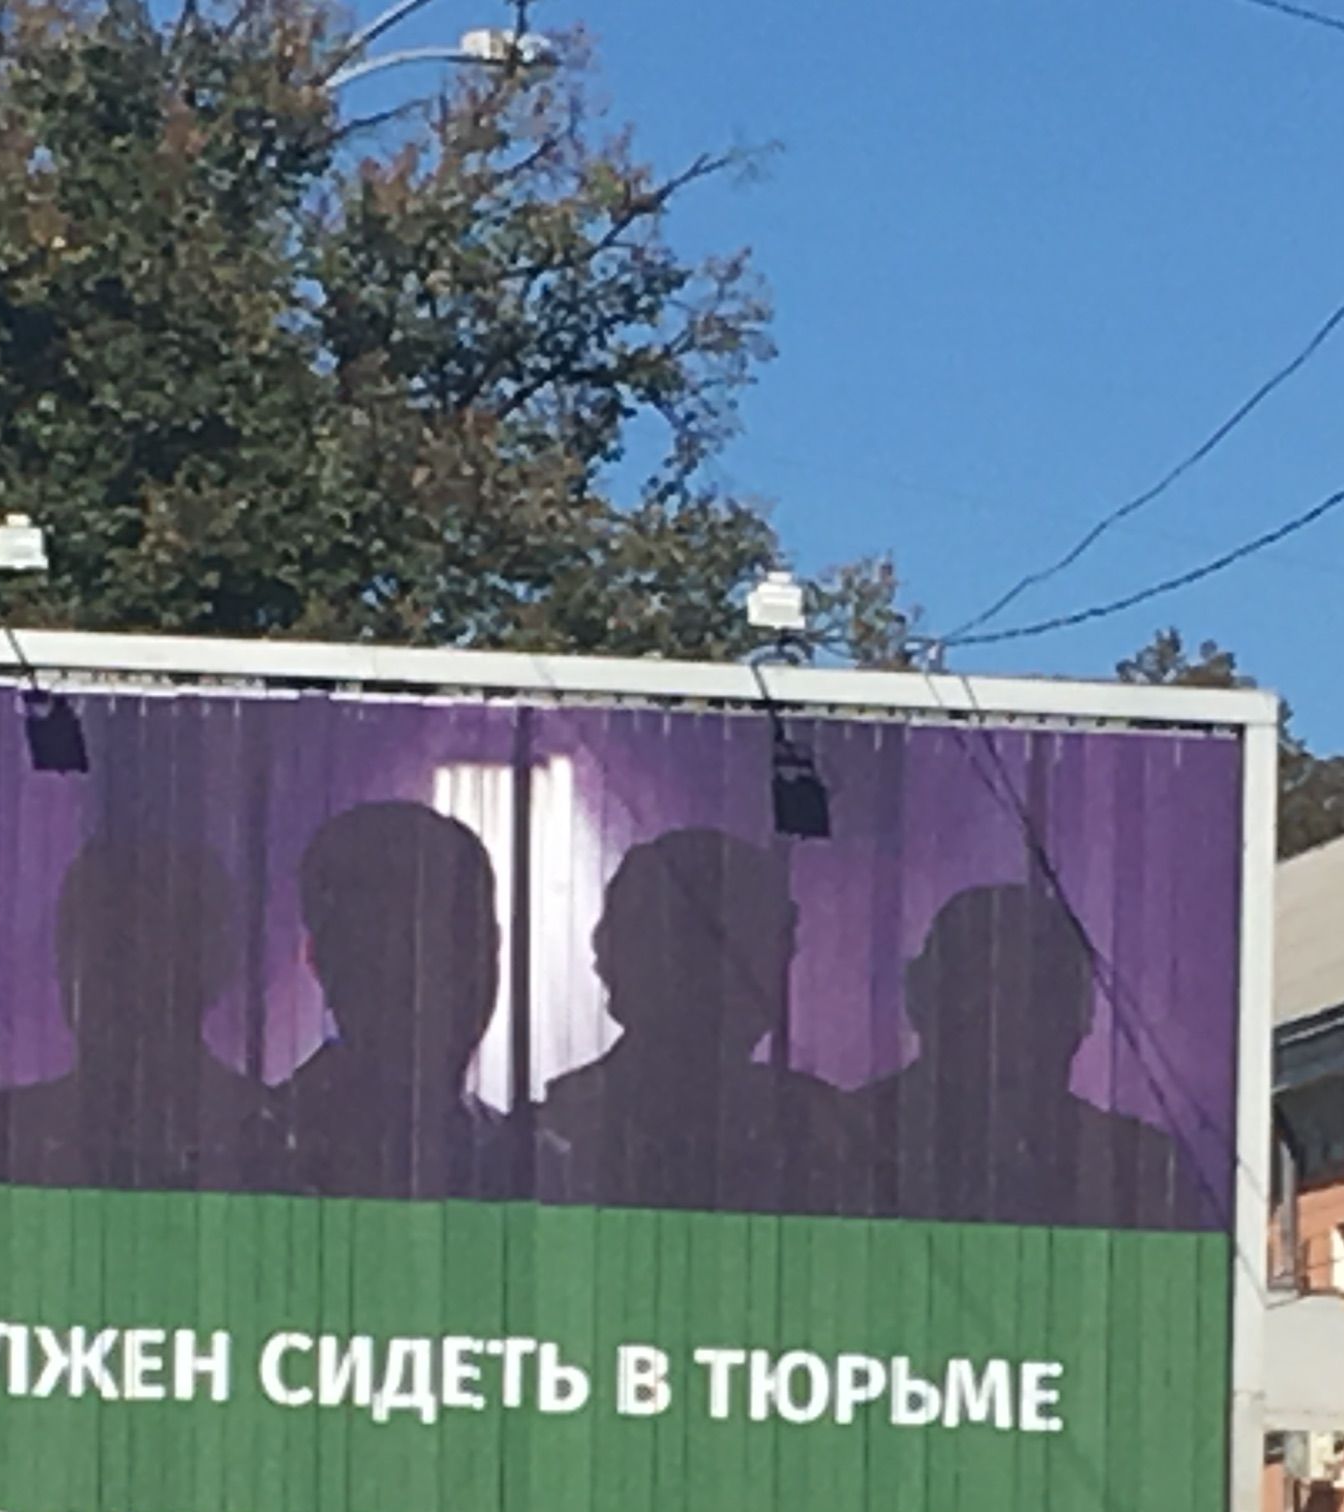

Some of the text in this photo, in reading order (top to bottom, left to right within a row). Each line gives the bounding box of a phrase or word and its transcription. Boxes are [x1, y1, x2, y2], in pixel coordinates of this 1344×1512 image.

[259, 1332, 590, 1424] СИДЕТЬ
[616, 1345, 672, 1416] В
[693, 1348, 1063, 1432] ТЮРЬМЕ
